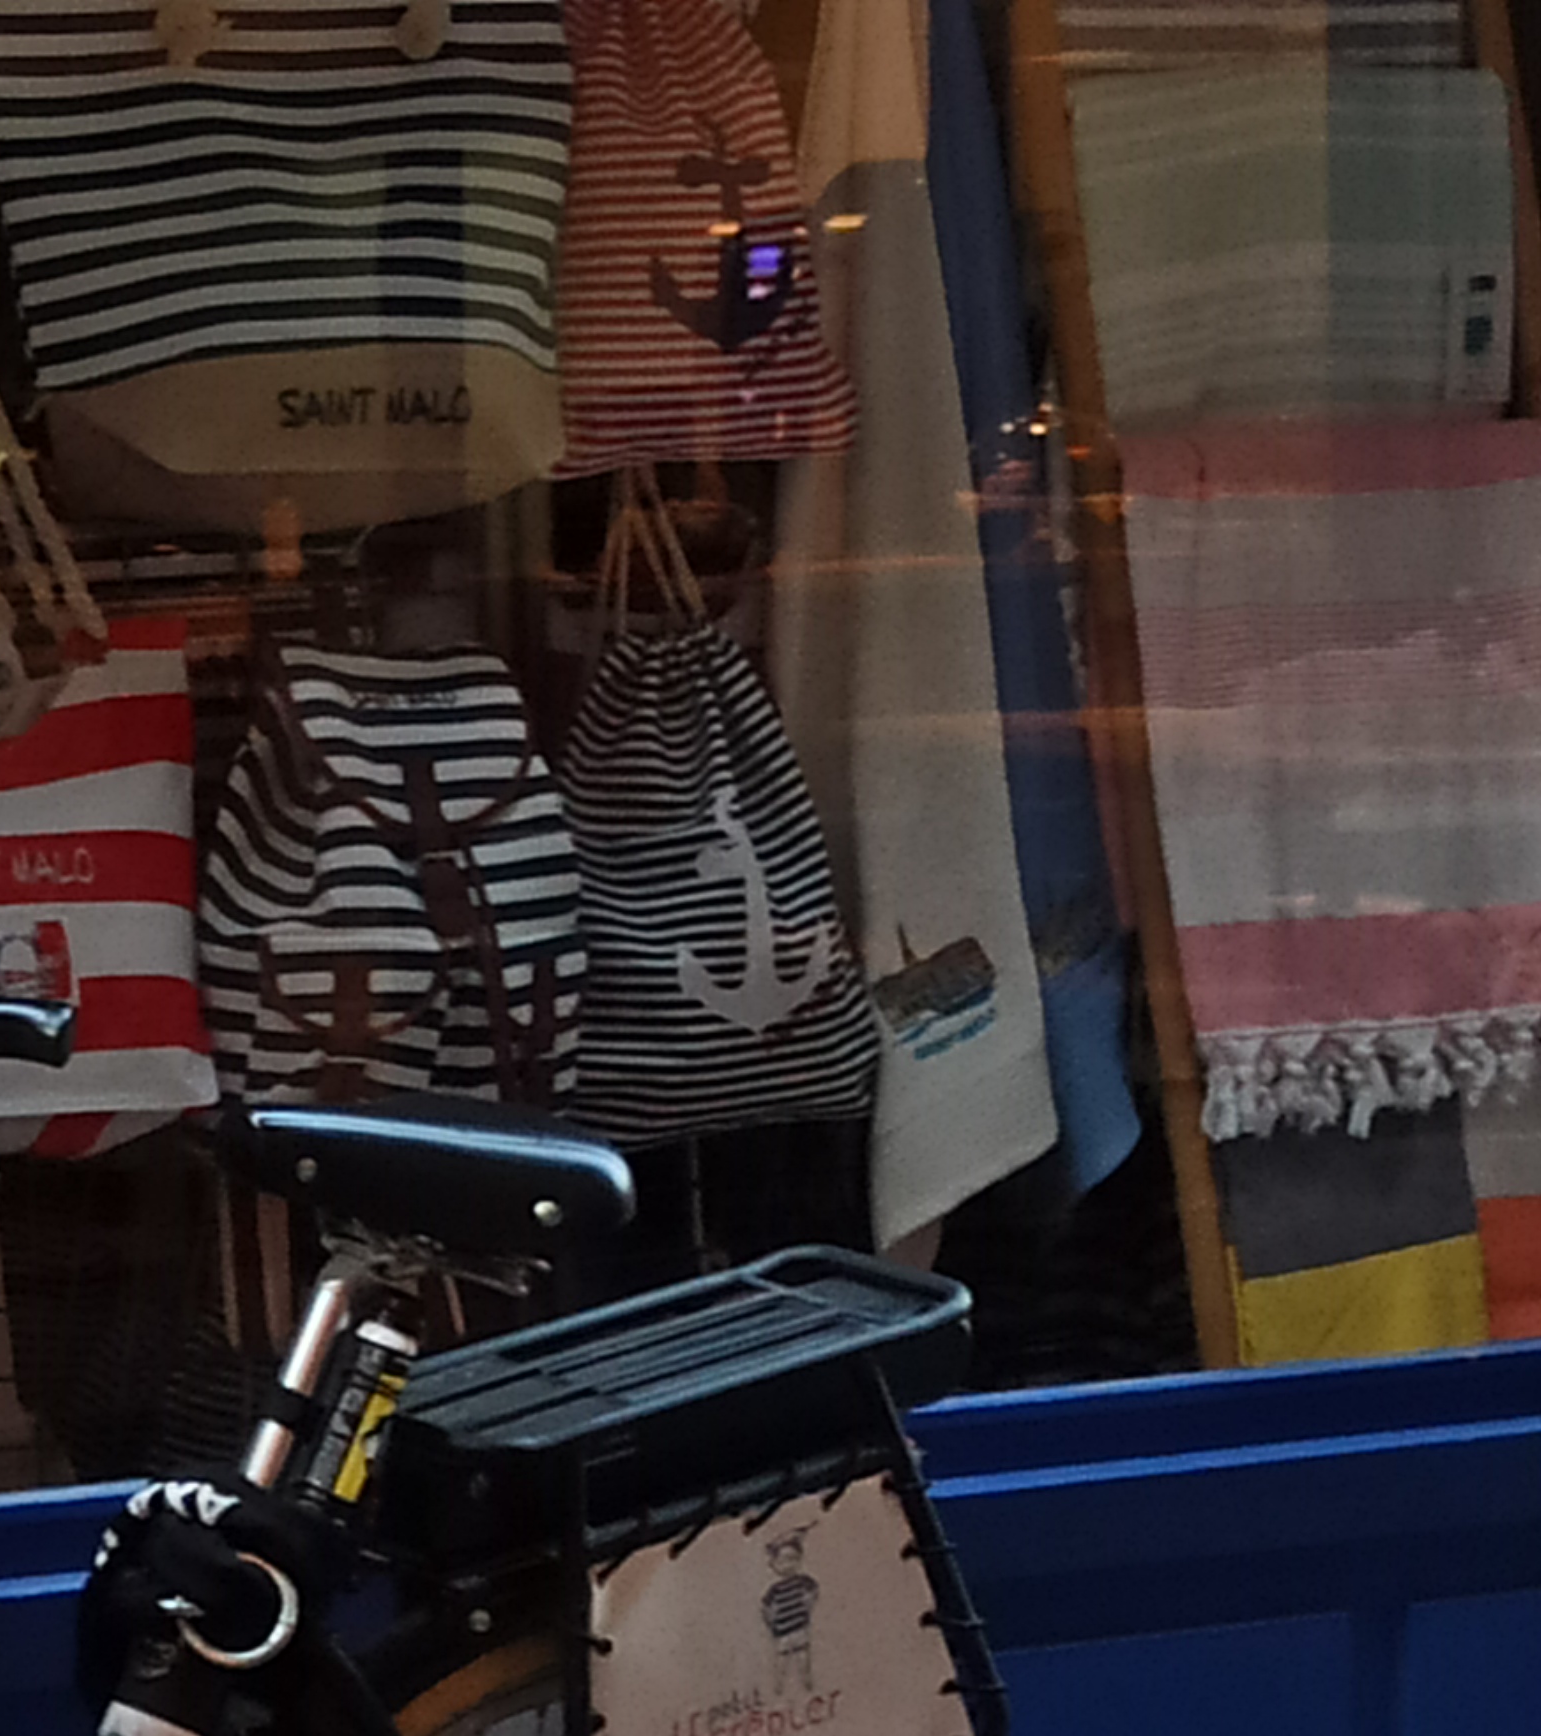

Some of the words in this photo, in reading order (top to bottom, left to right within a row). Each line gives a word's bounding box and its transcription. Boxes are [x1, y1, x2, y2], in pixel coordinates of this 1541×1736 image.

[277, 387, 377, 429] SAINT
[385, 384, 473, 425] MALO
[11, 846, 95, 886] MALO
